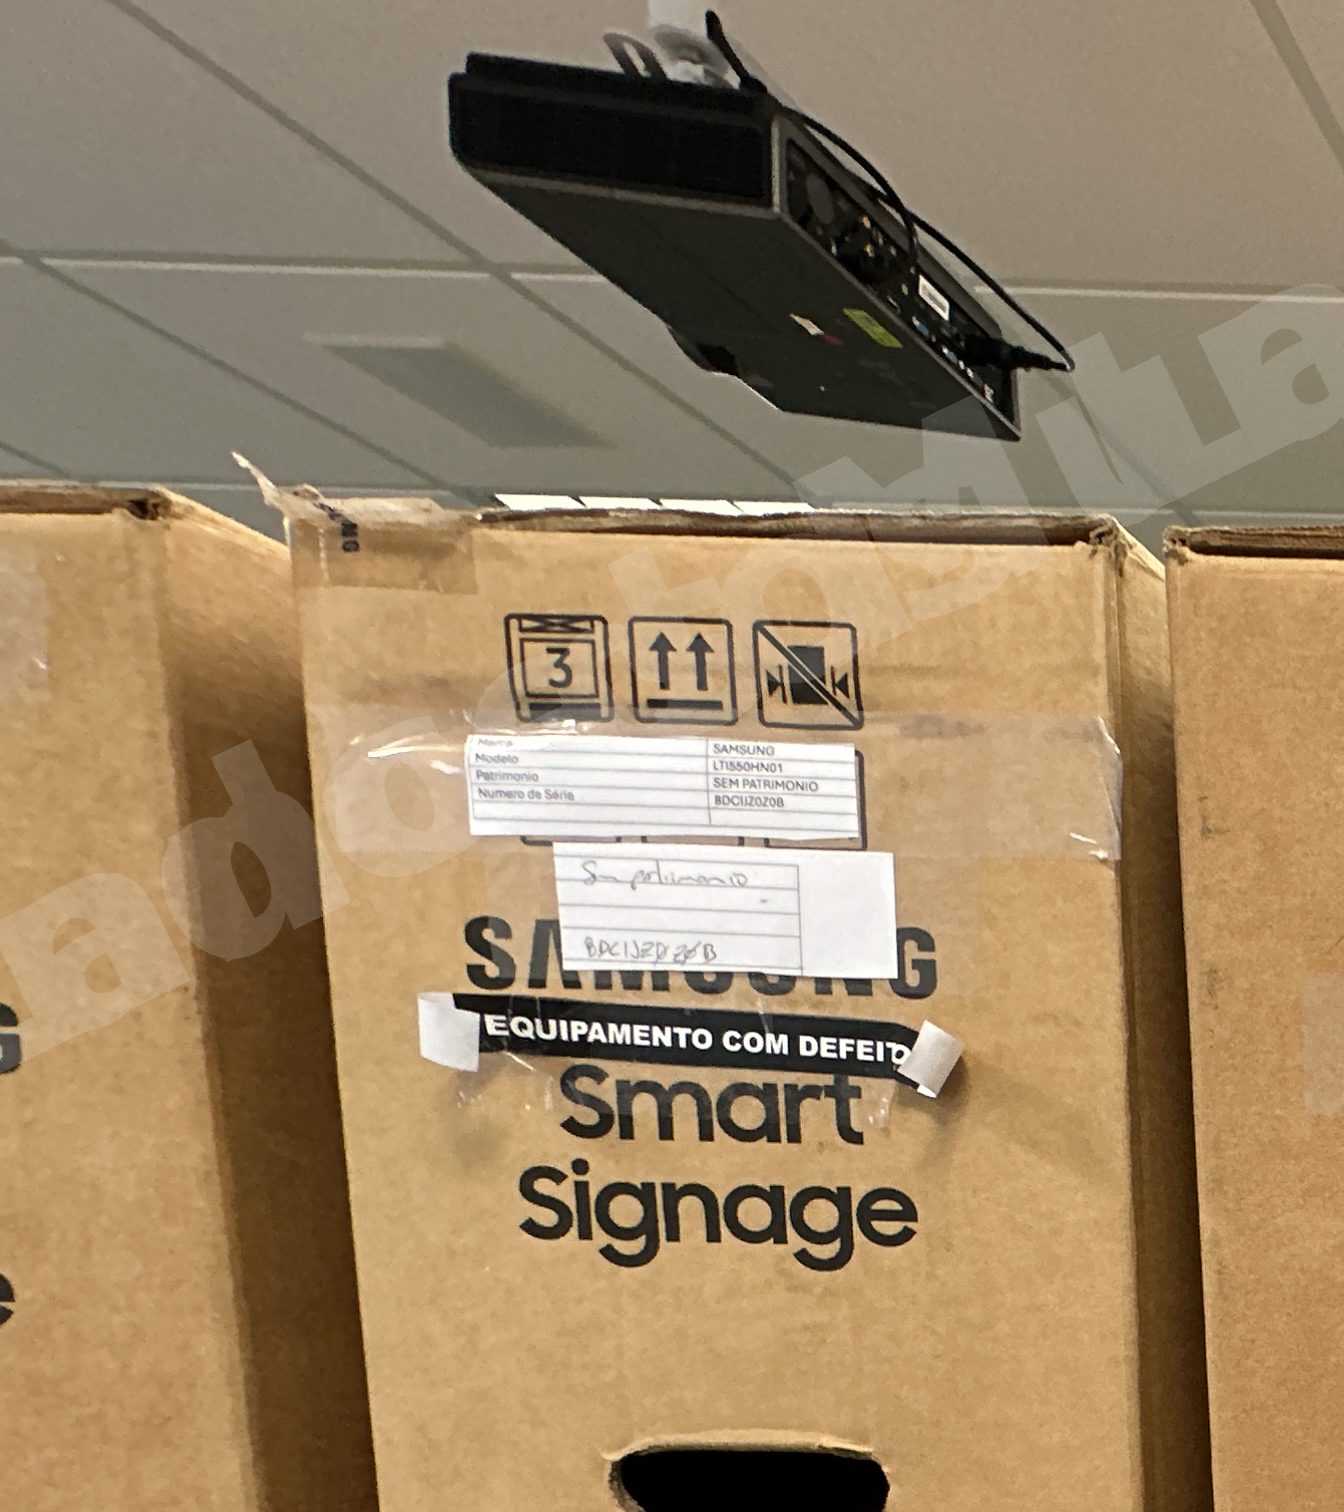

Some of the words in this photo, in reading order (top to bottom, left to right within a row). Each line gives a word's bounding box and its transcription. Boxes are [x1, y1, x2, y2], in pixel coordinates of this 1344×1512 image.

[713, 744, 775, 756] SAMSUNG
[475, 753, 519, 765] Modelo
[476, 770, 539, 783] Patrimonio
[713, 778, 739, 789] SEM
[742, 780, 818, 792] PATRIMONIO
[478, 787, 525, 799] Numero
[528, 789, 542, 799] de
[483, 1013, 713, 1049] EQUIPAMENTO
[722, 1031, 789, 1054] COM
[561, 1066, 864, 1144] Smart
[519, 1158, 919, 1271] Signage
